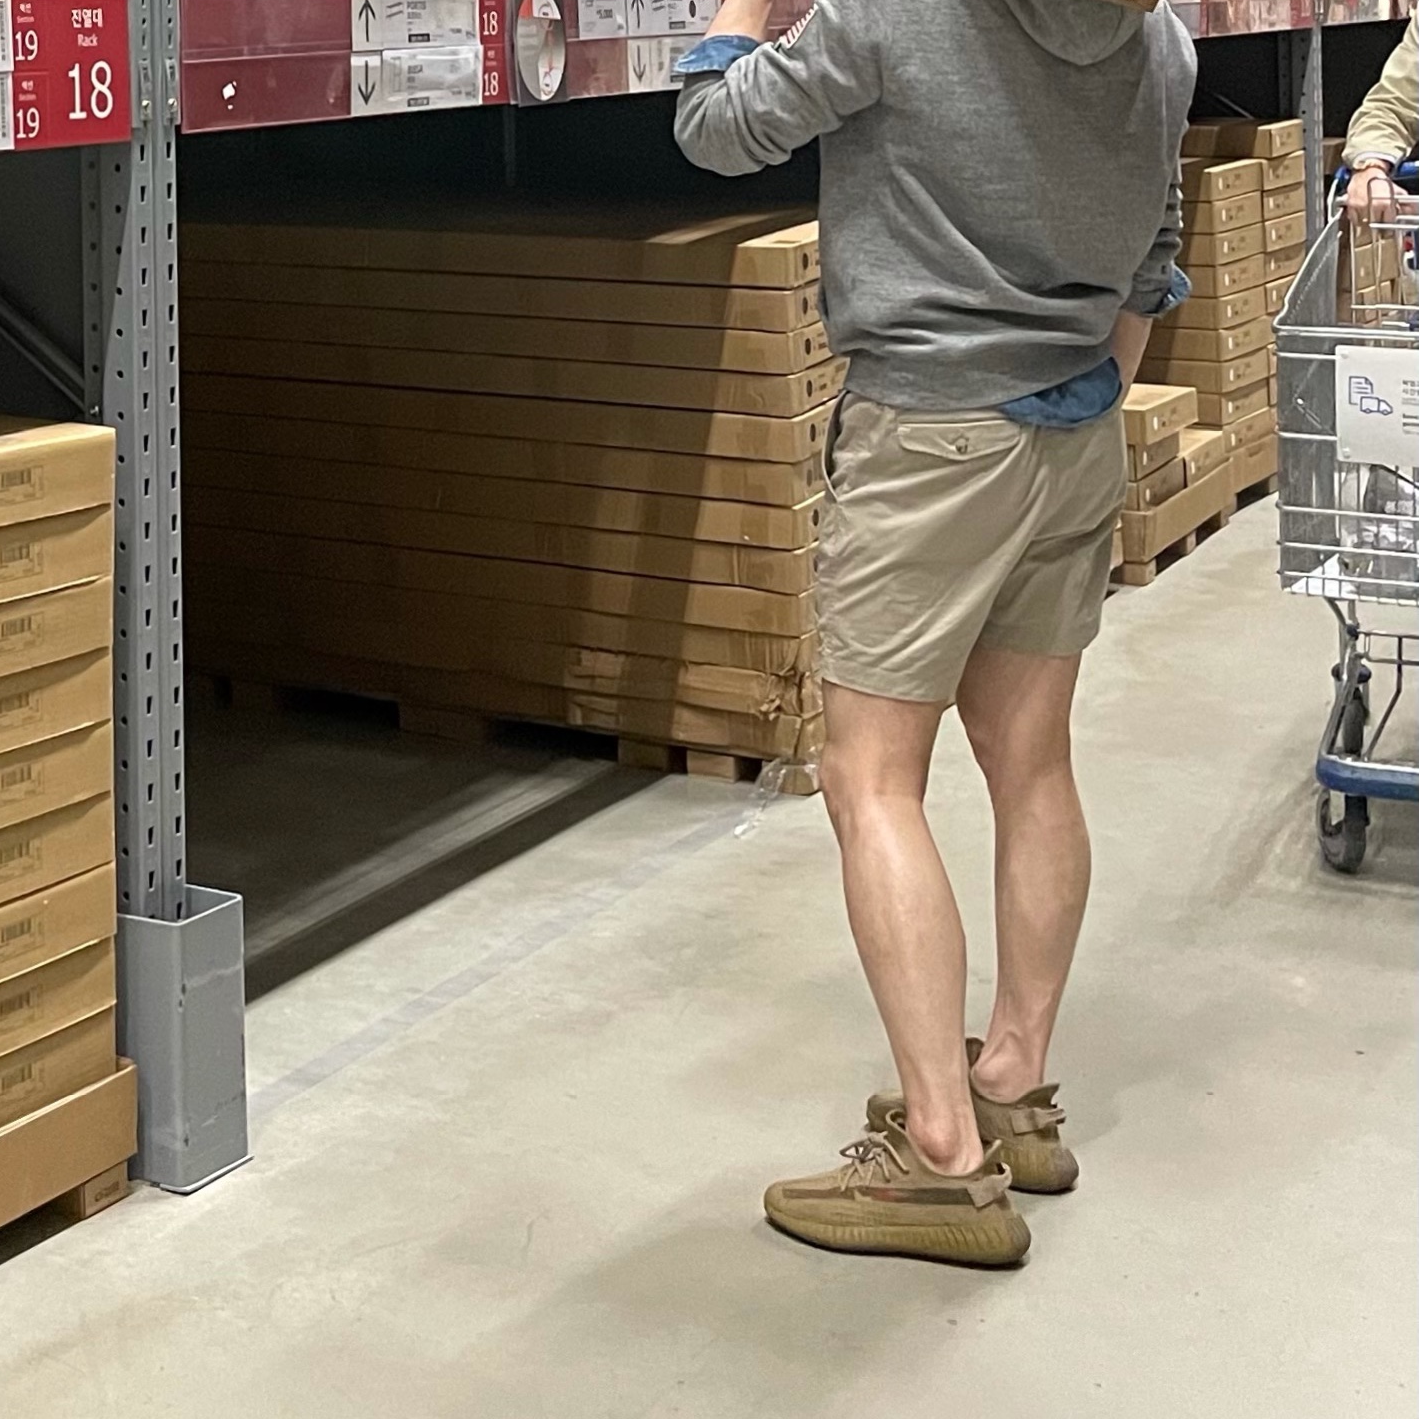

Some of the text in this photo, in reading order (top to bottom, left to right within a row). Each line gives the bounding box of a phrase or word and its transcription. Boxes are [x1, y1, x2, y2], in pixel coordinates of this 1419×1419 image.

[71, 8, 103, 28] 진열대
[483, 11, 498, 36] 18
[15, 30, 38, 61] 19
[78, 34, 98, 46] Rack
[68, 60, 114, 119] 18
[484, 72, 499, 96] 18
[16, 107, 40, 138] 19
